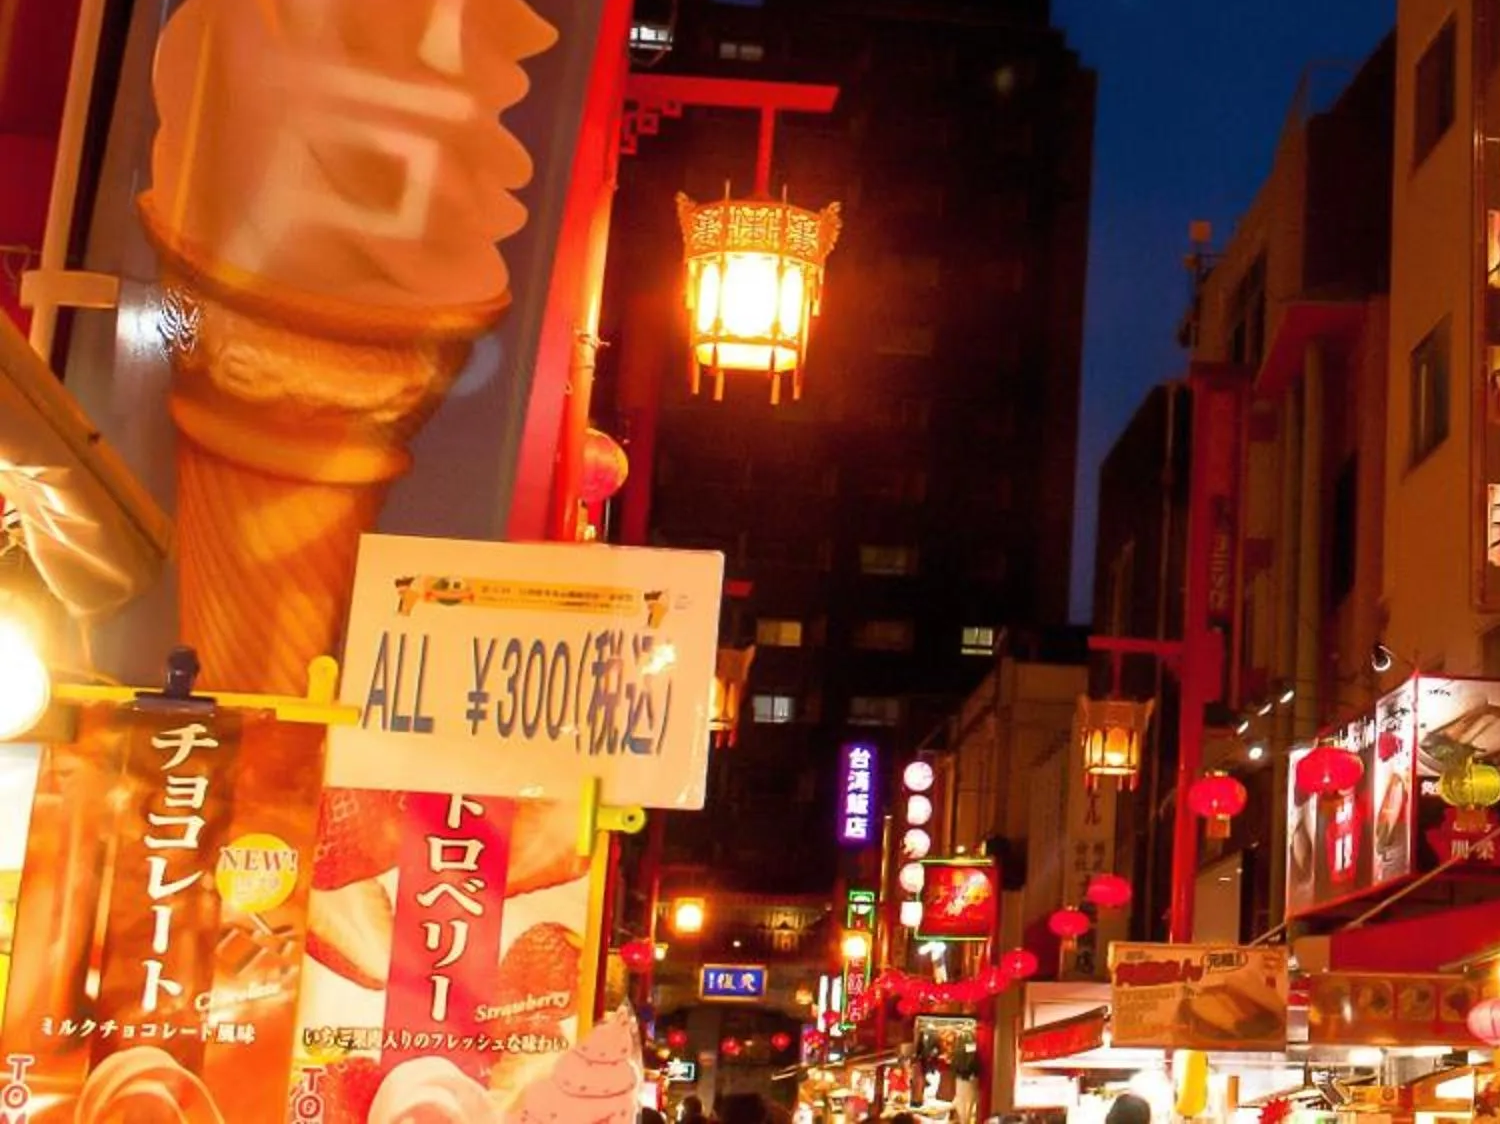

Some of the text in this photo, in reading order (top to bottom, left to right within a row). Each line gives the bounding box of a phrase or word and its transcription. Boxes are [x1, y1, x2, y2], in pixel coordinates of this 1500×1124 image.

[362, 631, 434, 734] ALL
[137, 721, 219, 1013] チョコレート
[219, 848, 298, 872] NEW!
[474, 990, 572, 1023] Strawberry
[41, 1016, 256, 1044] ミルクチョコレート風味
[296, 1067, 325, 1124] TO
